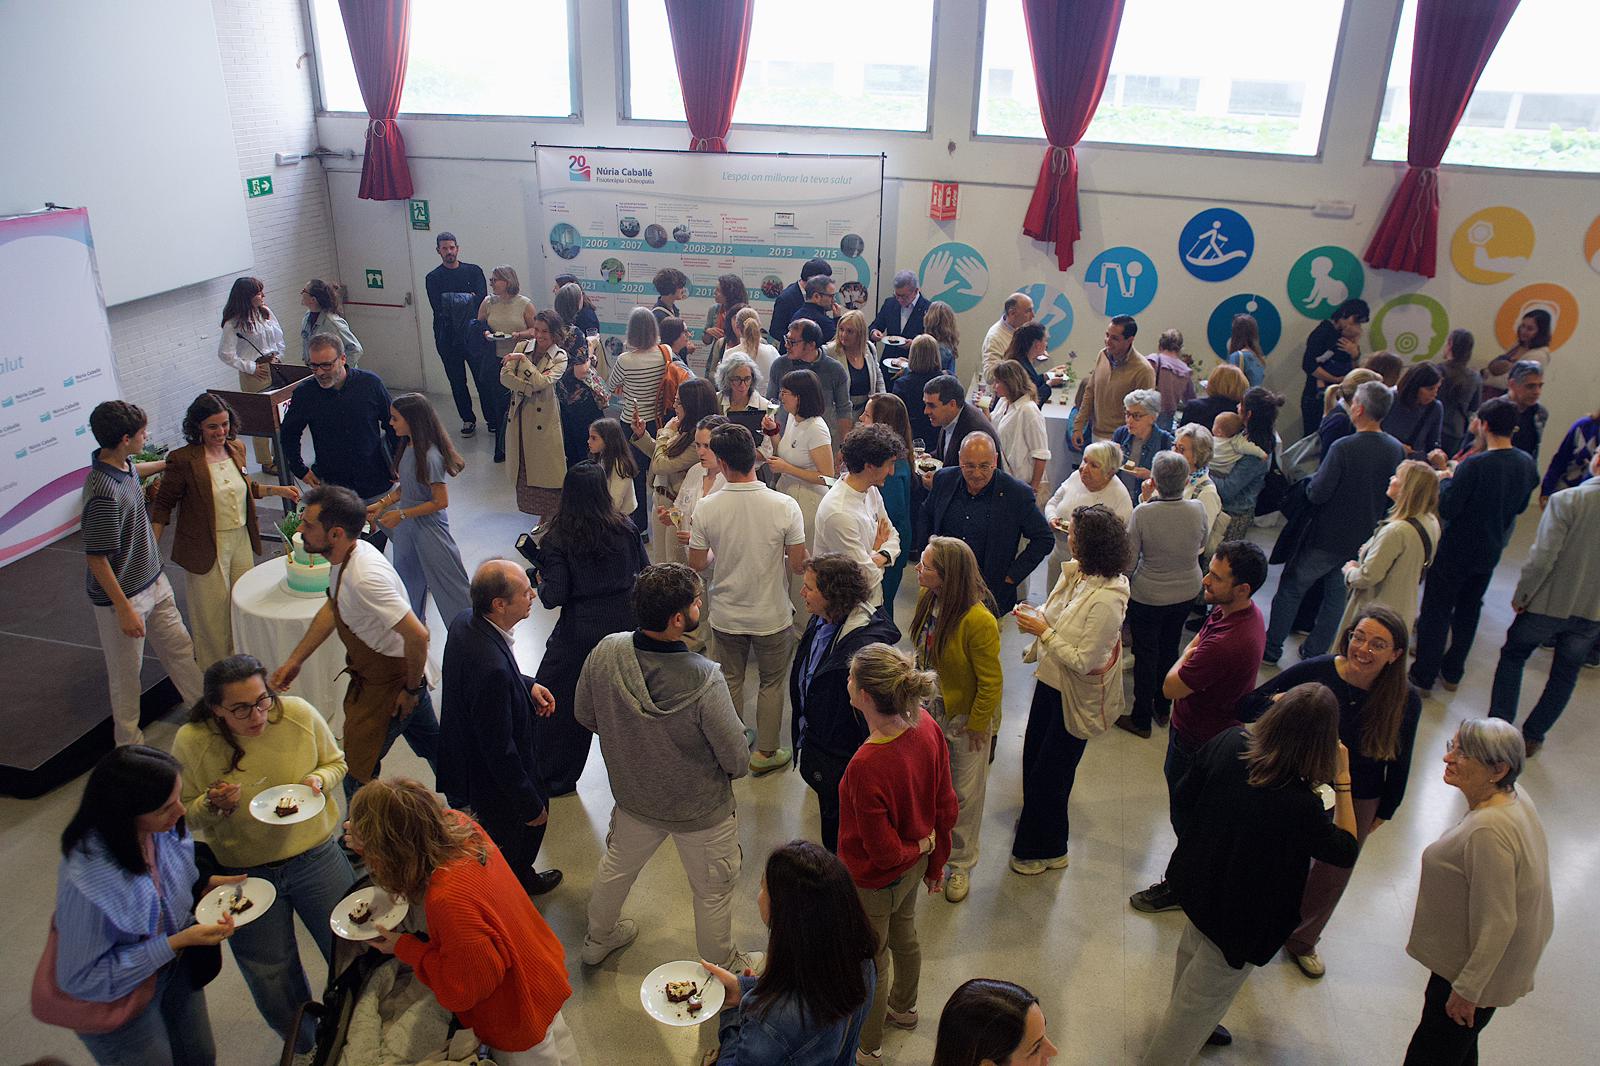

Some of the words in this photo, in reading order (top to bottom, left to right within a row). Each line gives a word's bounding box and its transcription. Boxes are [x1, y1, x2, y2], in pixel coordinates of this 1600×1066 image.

[569, 155, 586, 169] 20
[596, 167, 619, 176] Núria
[621, 168, 653, 177] Caballé
[764, 172, 798, 183] millorar
[799, 174, 809, 183] la
[830, 175, 852, 185] salut
[585, 239, 609, 248] 2006
[620, 240, 643, 250] 2007
[683, 244, 733, 255] 2008-2012
[769, 247, 793, 257] 2013
[814, 249, 838, 259] 2015
[581, 281, 597, 290] 021
[621, 283, 645, 293] 2020
